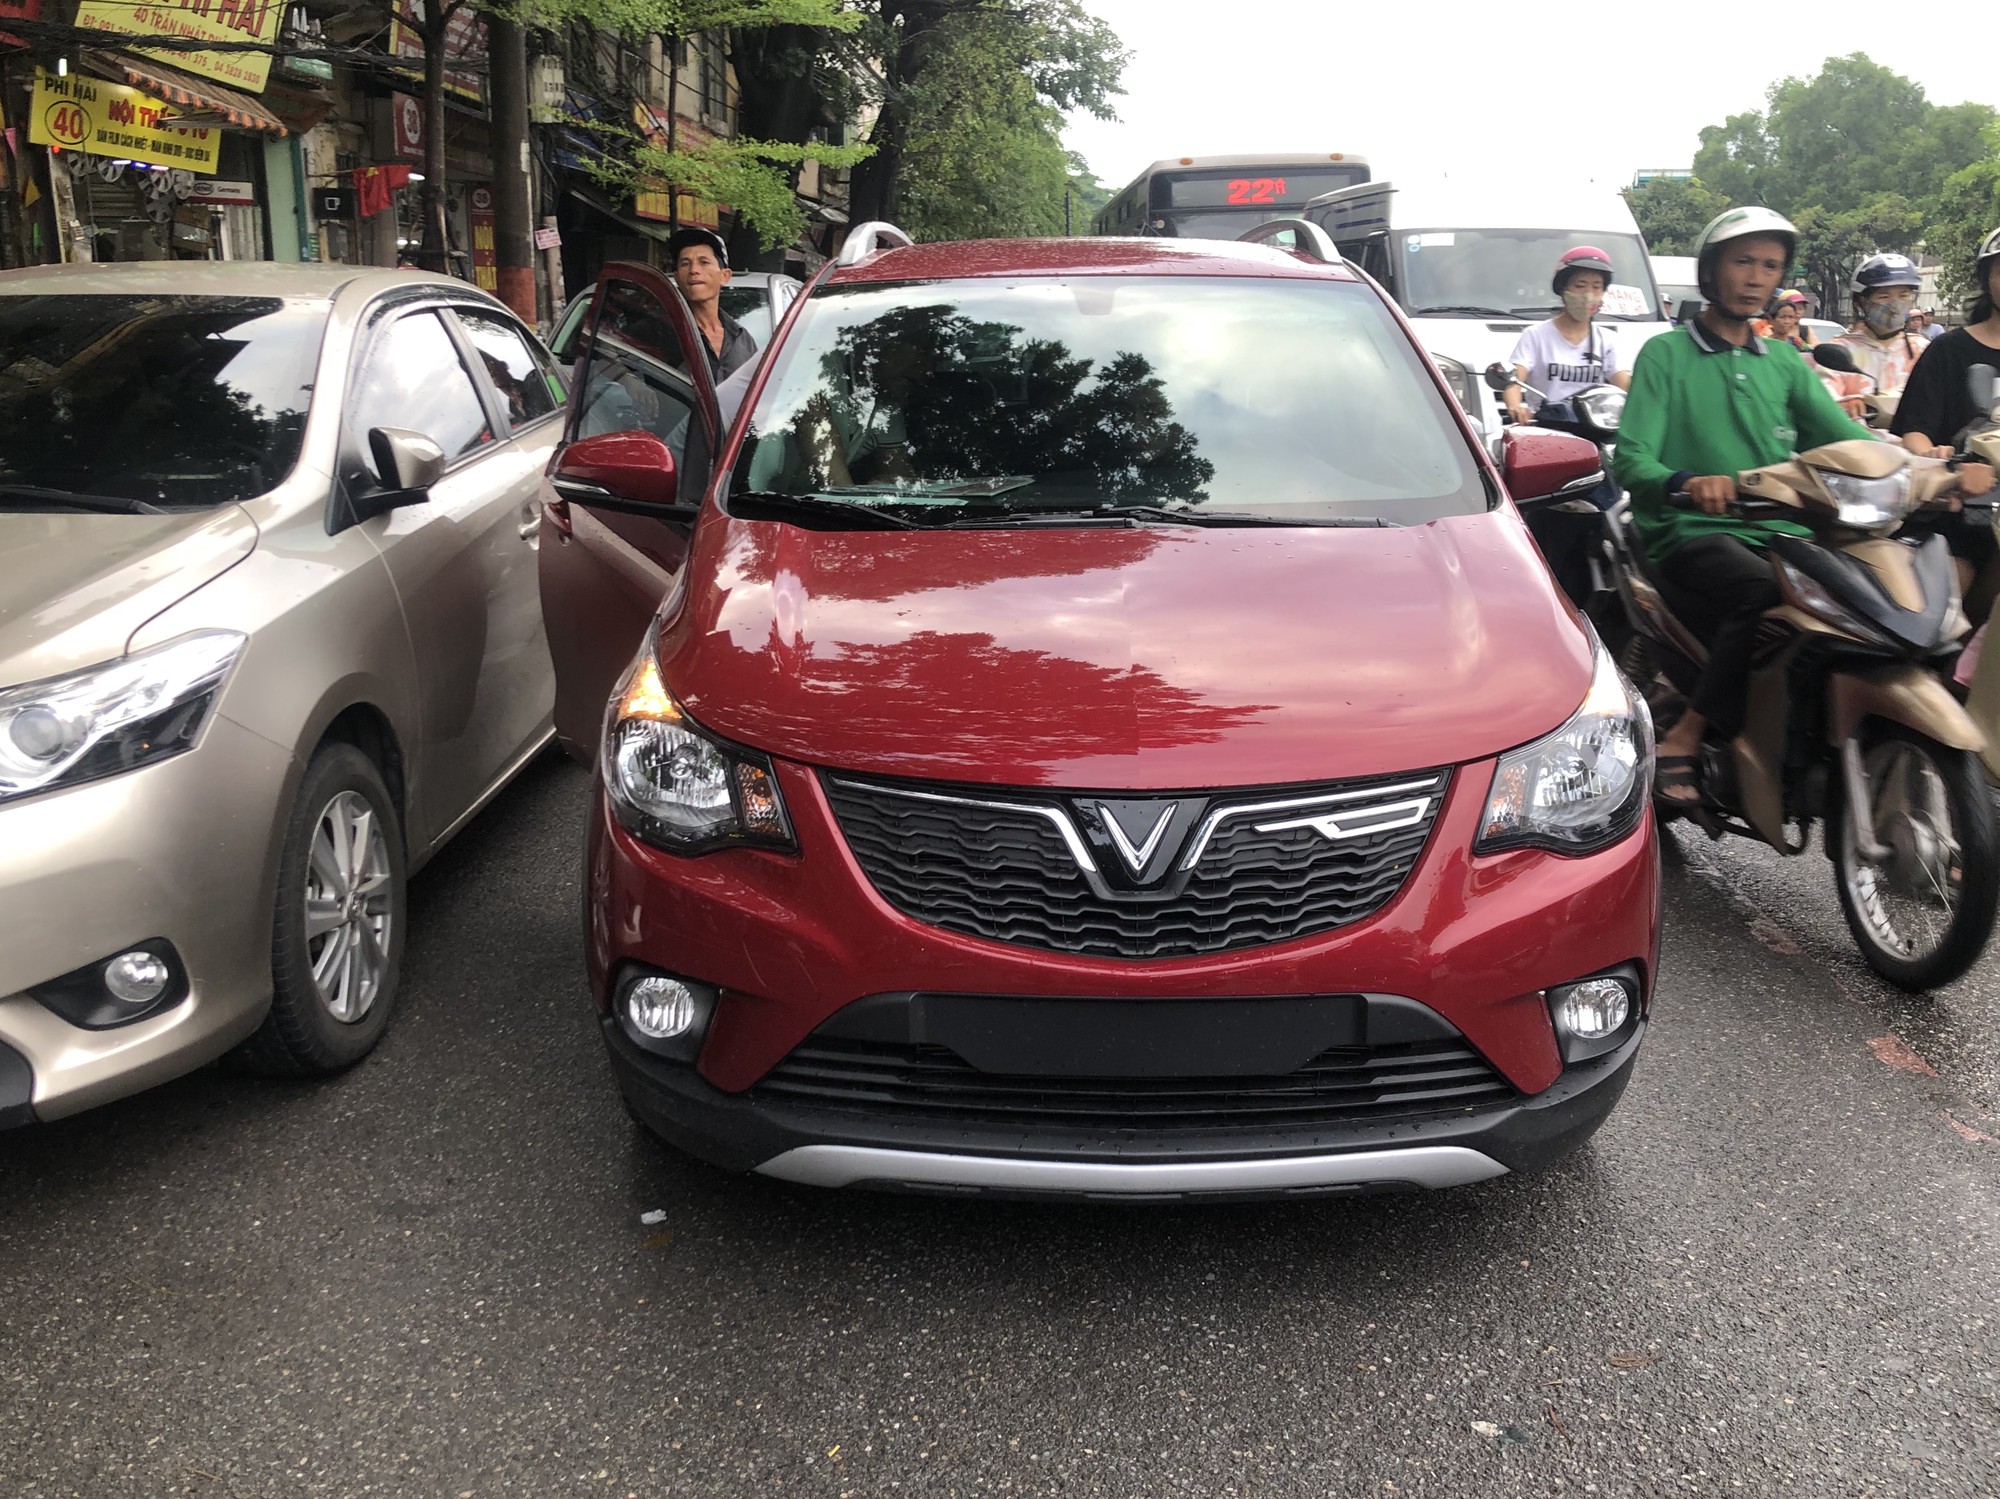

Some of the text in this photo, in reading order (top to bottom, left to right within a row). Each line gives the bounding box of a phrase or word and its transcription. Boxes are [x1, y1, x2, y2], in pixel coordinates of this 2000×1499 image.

[133, 7, 148, 23] 40
[44, 76, 69, 96] PHI
[53, 106, 83, 139] 40
